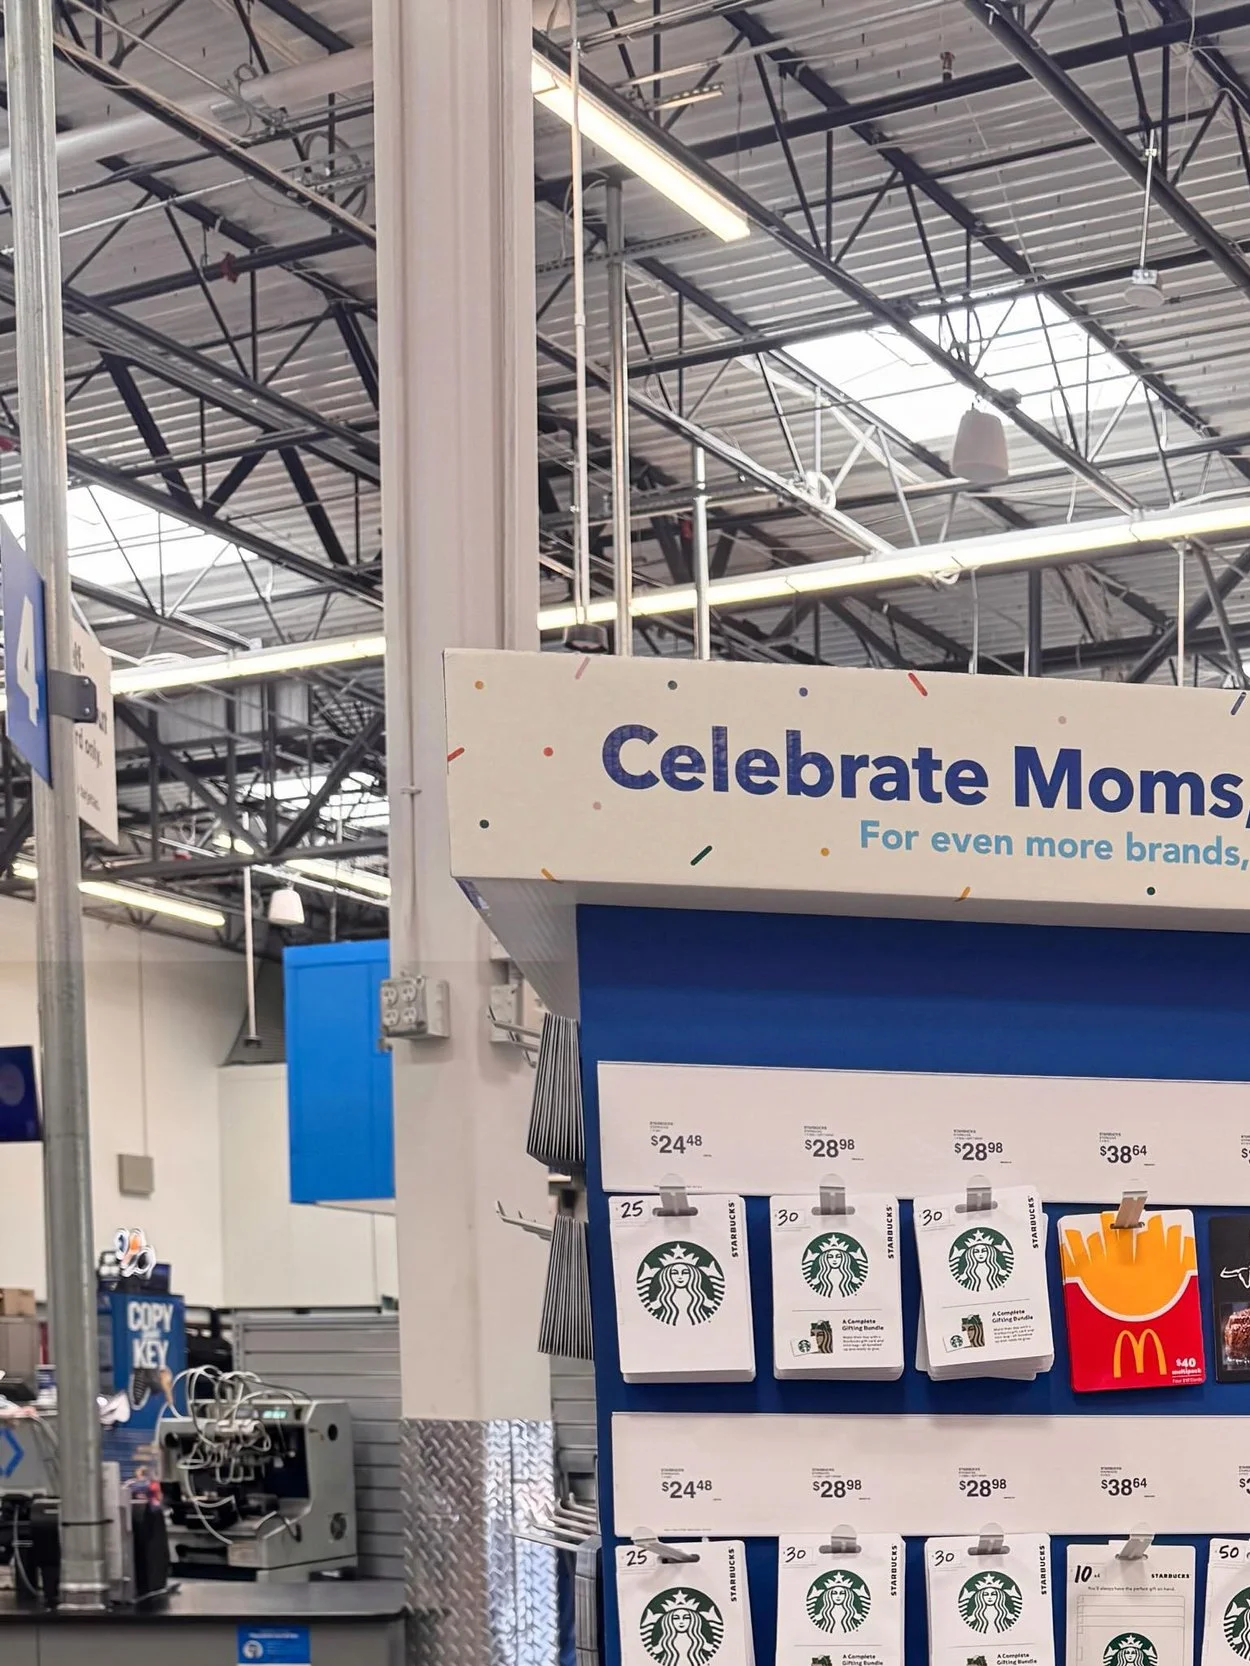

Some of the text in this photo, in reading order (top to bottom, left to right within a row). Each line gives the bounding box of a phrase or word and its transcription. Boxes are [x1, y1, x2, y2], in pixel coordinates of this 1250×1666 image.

[17, 594, 39, 727] 4
[601, 724, 989, 806] Celebrate
[860, 820, 918, 851] For
[931, 830, 1014, 856] even
[1026, 835, 1114, 861] more
[1126, 833, 1250, 870] brands,
[621, 1201, 643, 1218] 25
[778, 1209, 799, 1226] 30
[728, 1200, 739, 1258] STARBUCKS
[127, 1301, 173, 1333] COPY
[848, 1318, 877, 1327] Complete
[842, 1325, 862, 1333] Gifting
[133, 1340, 169, 1369] KEY
[1175, 1357, 1197, 1369] $40
[1073, 1565, 1093, 1583] 10
